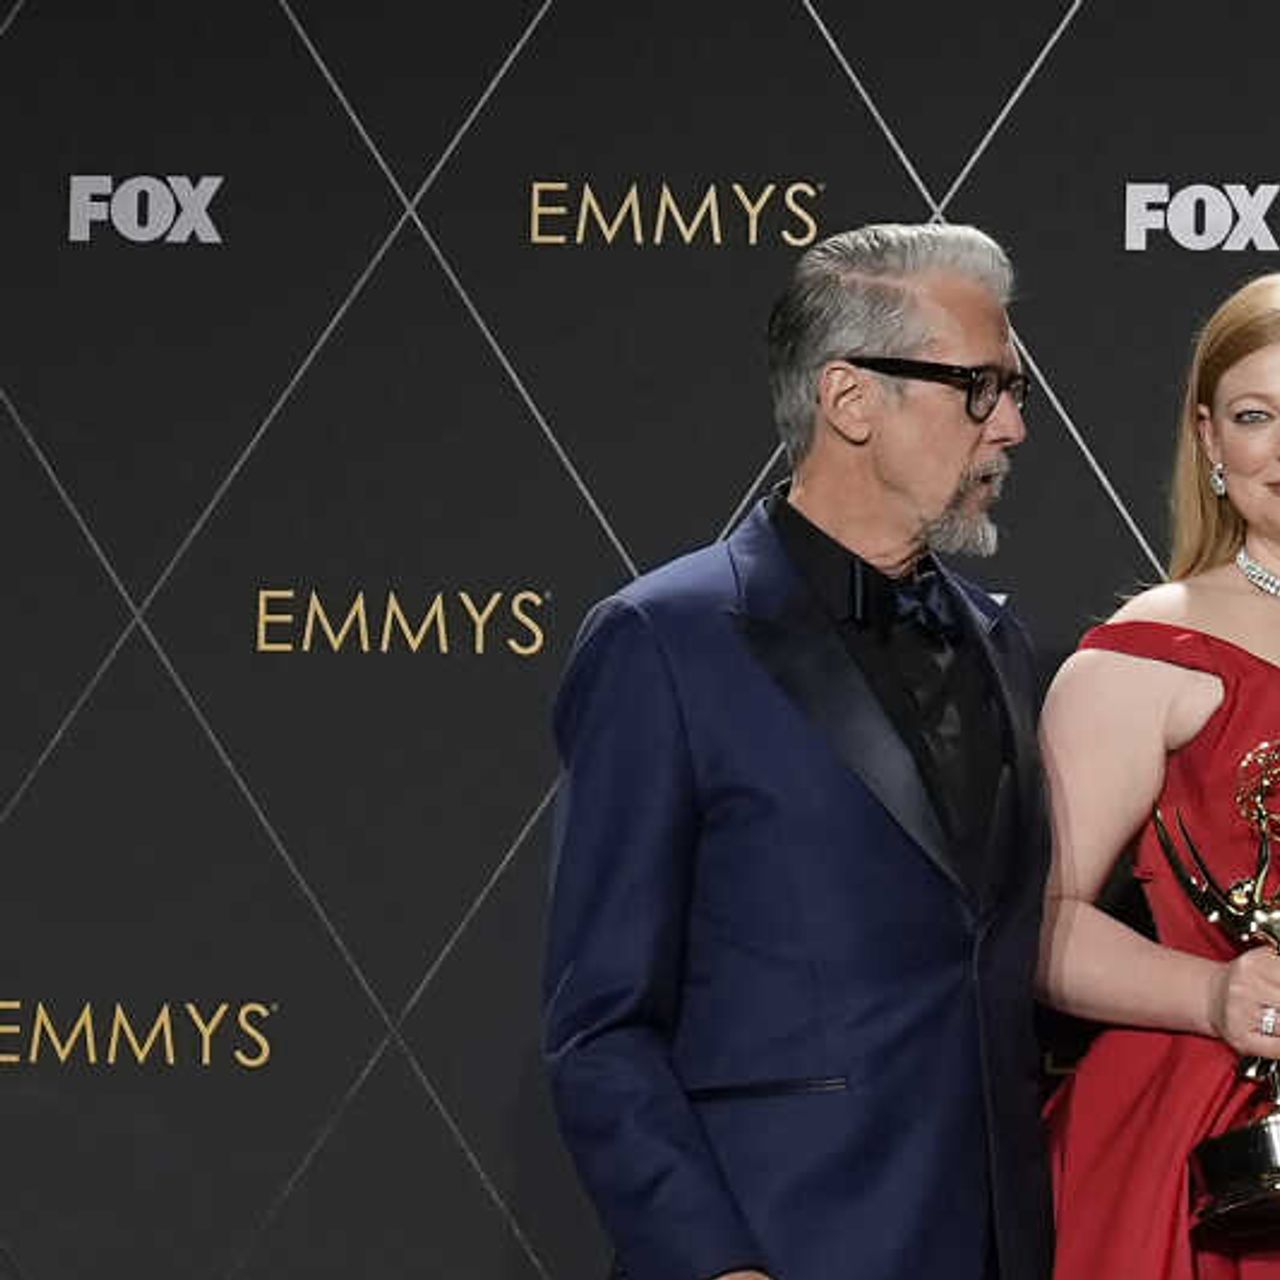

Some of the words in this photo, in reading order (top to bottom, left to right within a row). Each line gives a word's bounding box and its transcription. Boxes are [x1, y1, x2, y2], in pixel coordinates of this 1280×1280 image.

[69, 176, 223, 243] FOX
[530, 182, 817, 246] EMMYS
[1125, 183, 1280, 251] FOX
[257, 589, 544, 655] EMMYS
